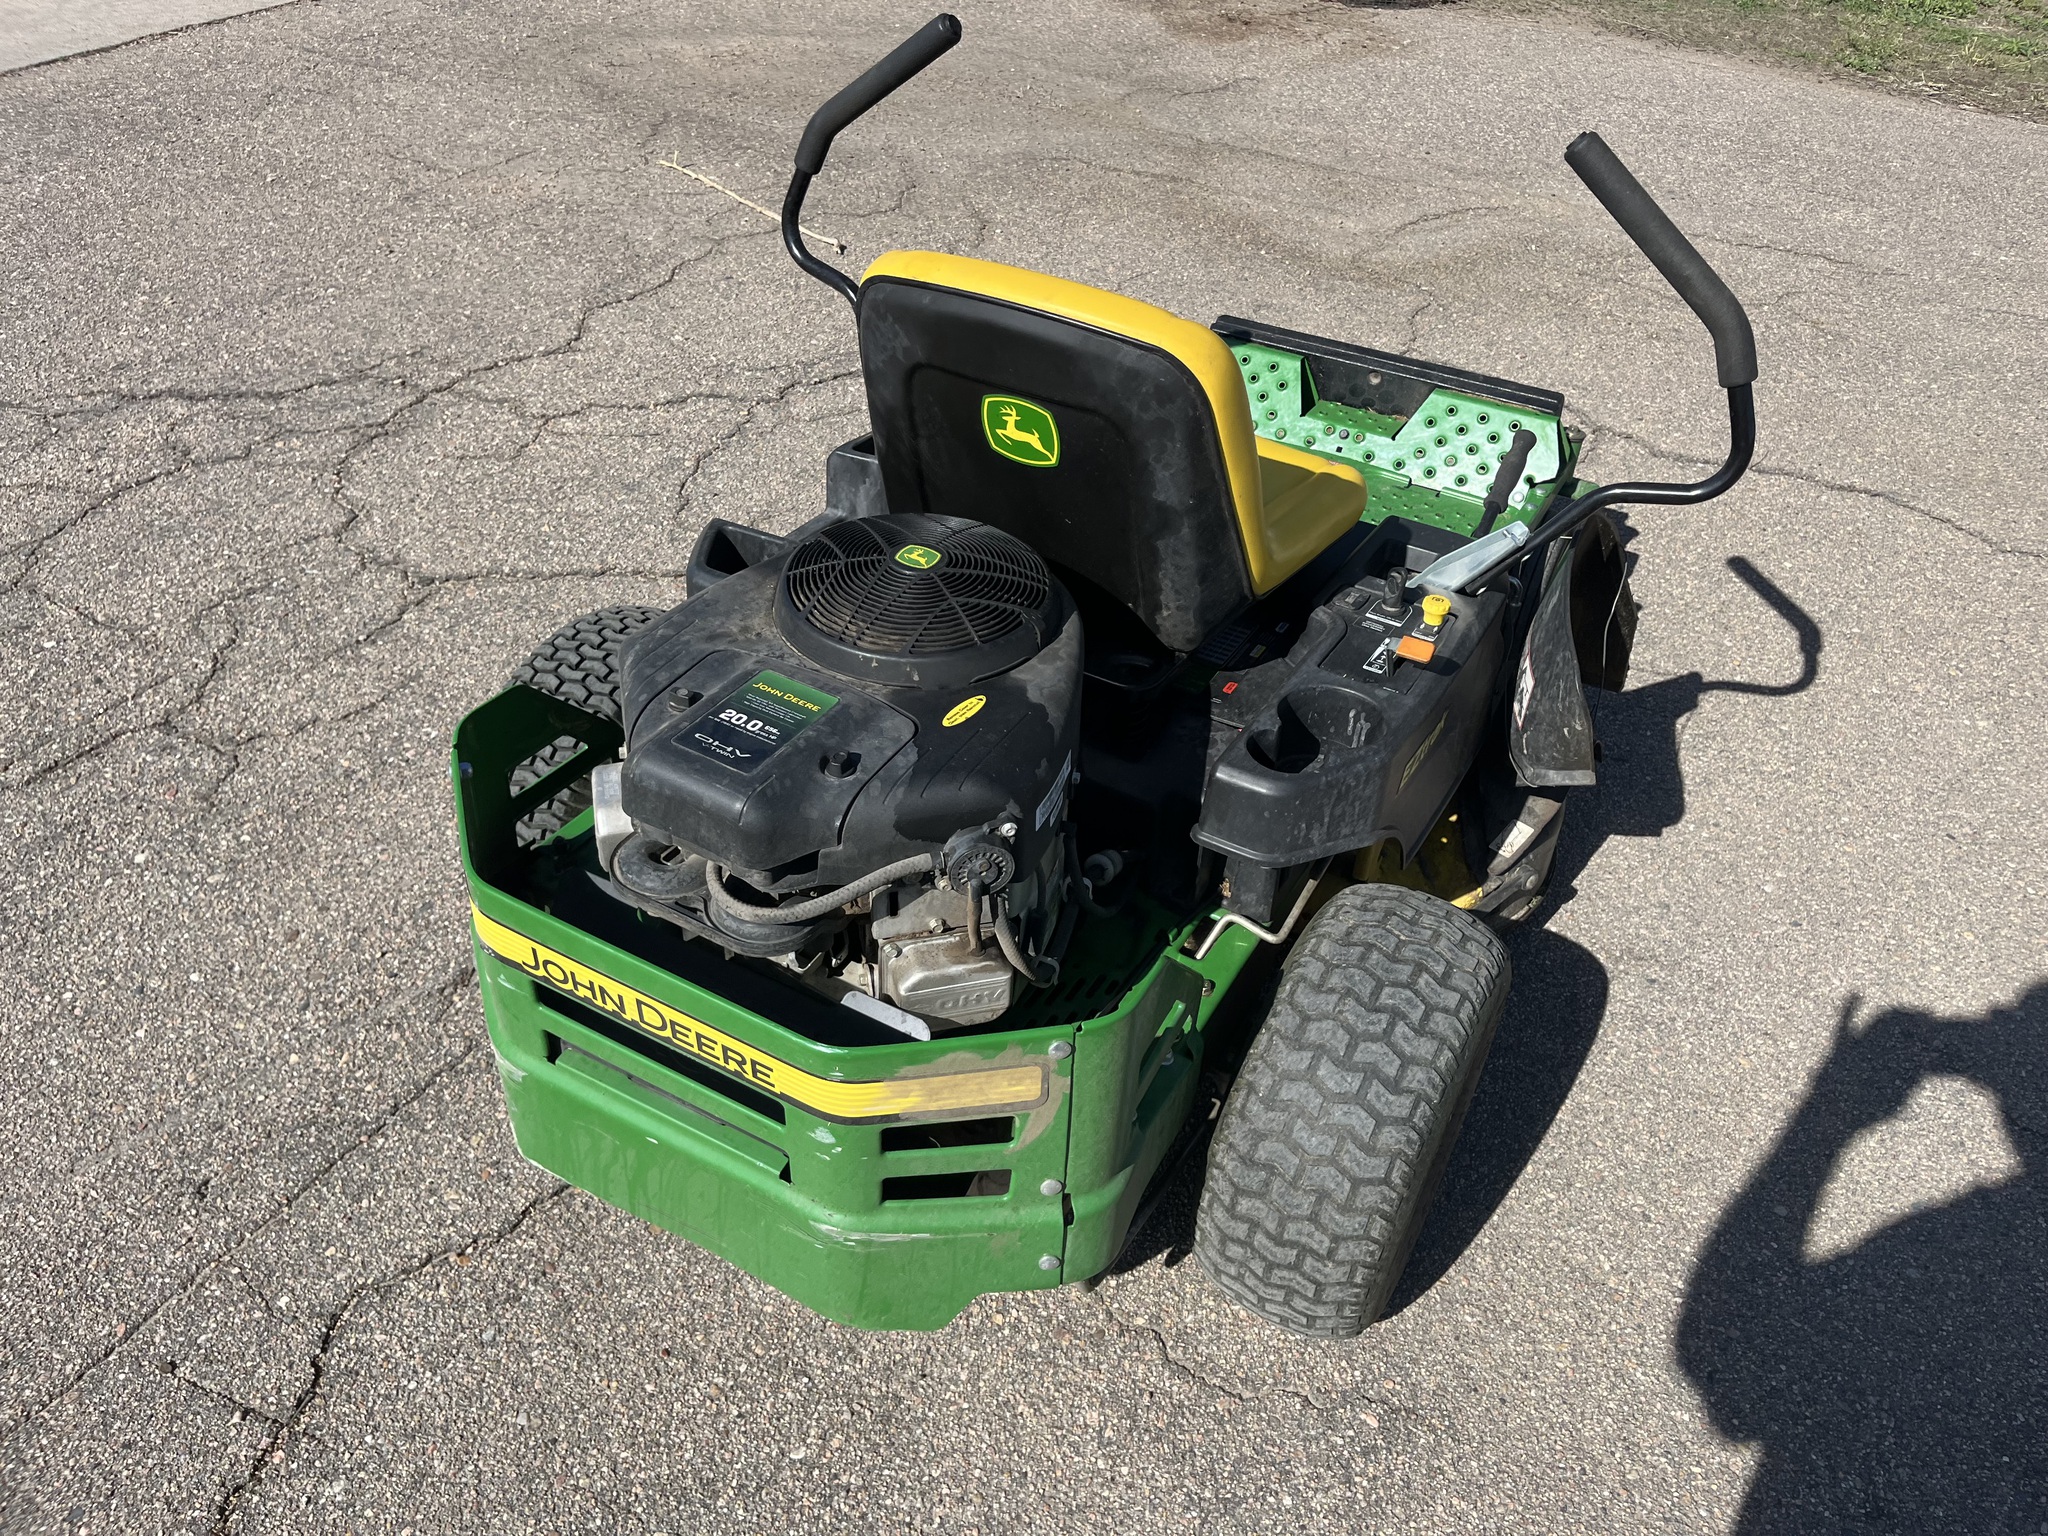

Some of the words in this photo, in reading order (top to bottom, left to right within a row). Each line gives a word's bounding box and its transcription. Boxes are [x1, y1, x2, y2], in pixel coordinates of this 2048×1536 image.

[752, 682, 783, 697] JOHN
[784, 693, 821, 712] DEERE
[718, 709, 764, 731] 20.0
[694, 733, 752, 757] OHV
[522, 947, 627, 1015] JOHN
[635, 998, 776, 1089] DEERE
